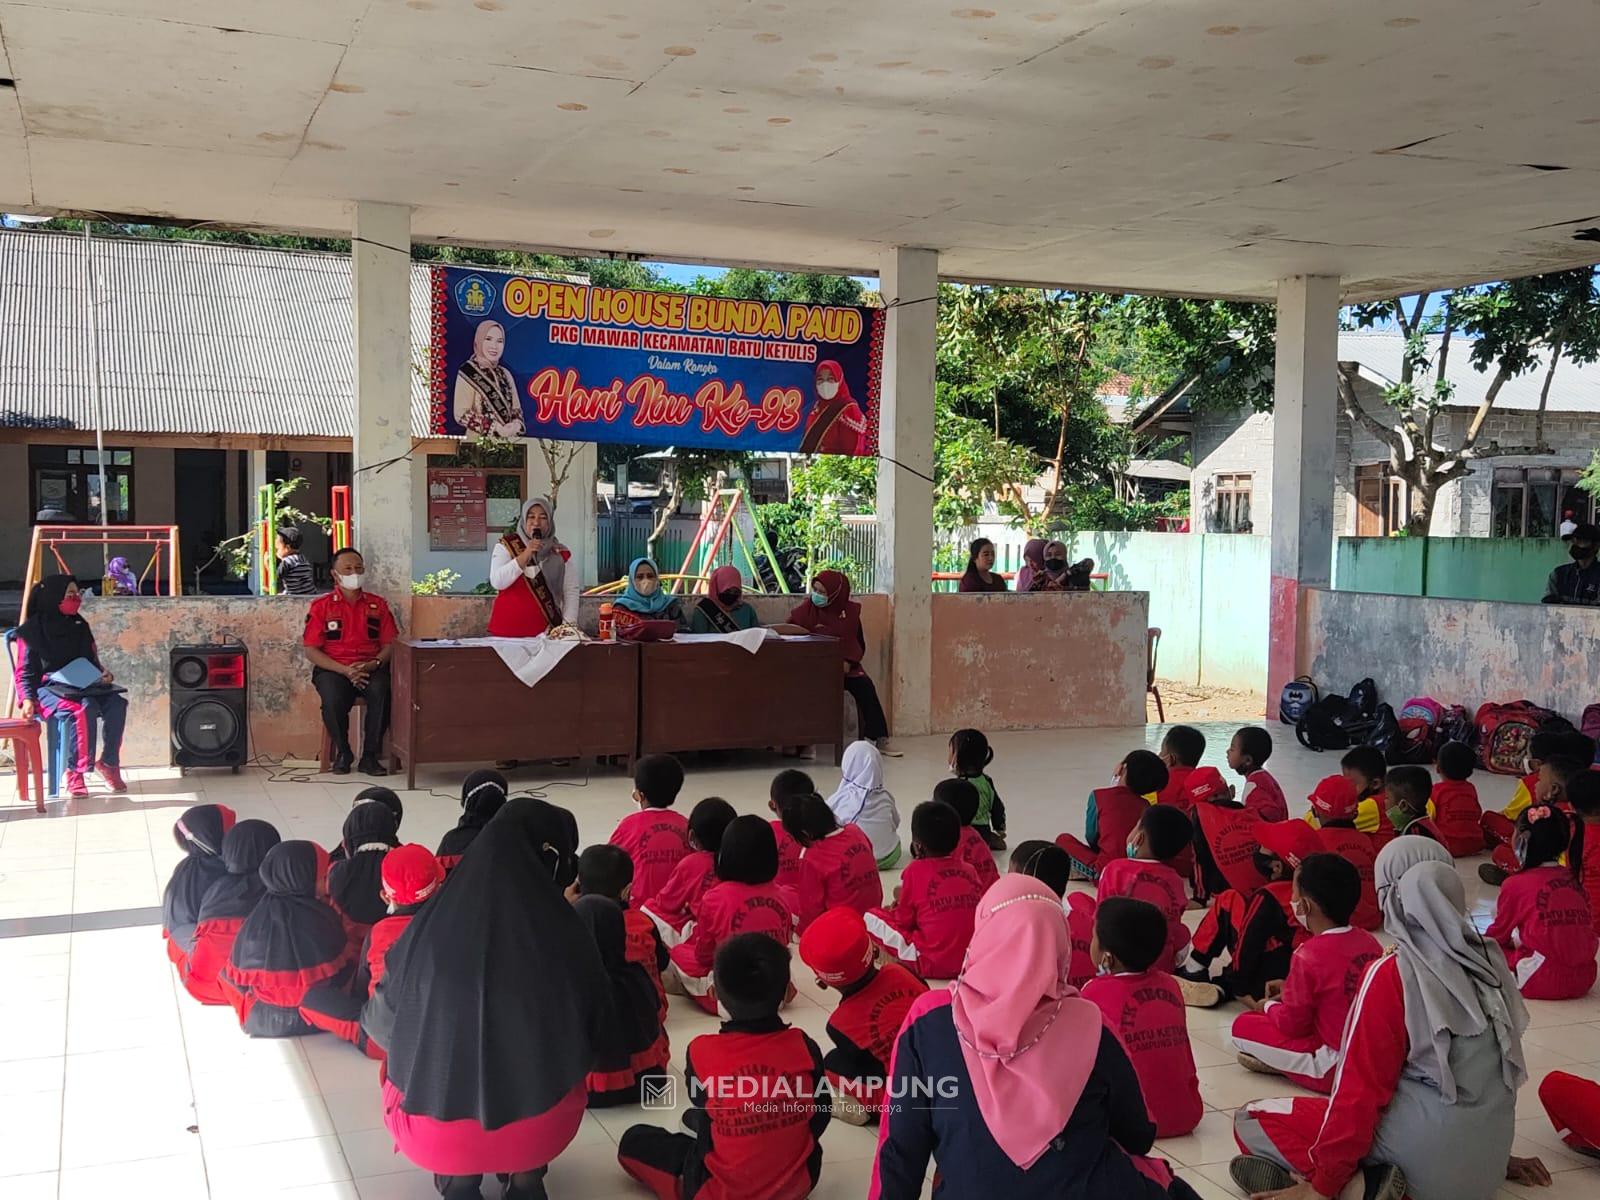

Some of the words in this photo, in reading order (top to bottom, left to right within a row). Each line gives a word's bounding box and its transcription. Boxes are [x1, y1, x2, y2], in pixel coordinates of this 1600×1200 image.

[503, 277, 589, 321] OPEN
[590, 286, 687, 329] HOUSE
[688, 296, 784, 339] BUNDA
[785, 304, 863, 344] PAUD
[550, 323, 578, 344] PKG
[581, 326, 640, 349] MAWAR
[642, 330, 726, 356] KECAMATAN
[727, 339, 763, 360] BATU
[764, 342, 817, 363] KETULIS
[648, 355, 682, 371] Dalam
[683, 358, 718, 377] Rangka
[528, 366, 623, 426] Hari
[625, 374, 693, 427] Ibu
[695, 377, 803, 436] Ke-93
[1121, 1001, 1137, 1028] TK
[1125, 1028, 1156, 1044] BATU
